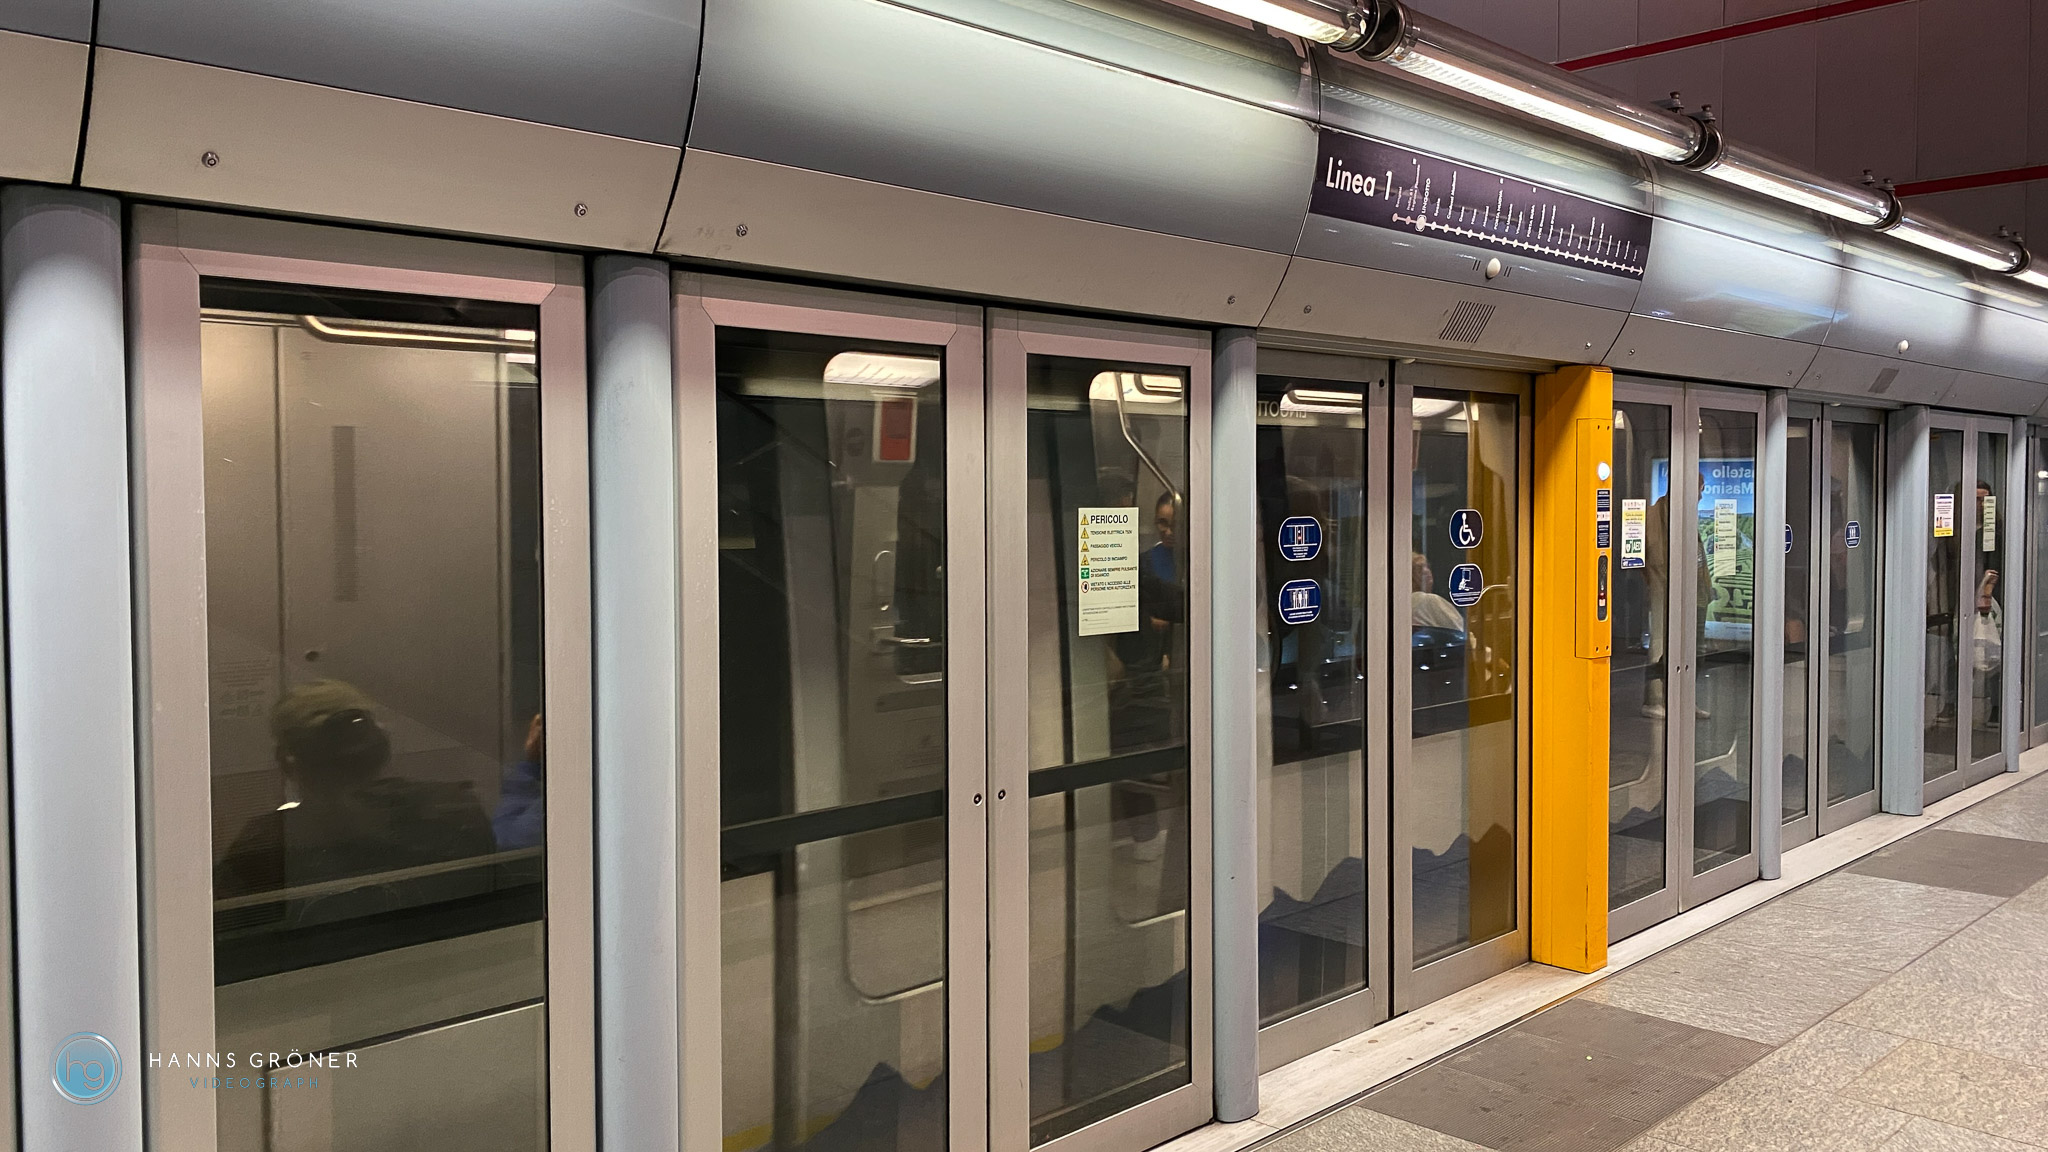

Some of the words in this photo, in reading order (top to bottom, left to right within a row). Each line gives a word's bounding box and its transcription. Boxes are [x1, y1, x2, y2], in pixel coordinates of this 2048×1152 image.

[1326, 156, 1376, 197] Linea
[1385, 170, 1393, 201] 1
[1421, 178, 1431, 214] LINGOTTO
[1090, 514, 1129, 524] PERICOLO
